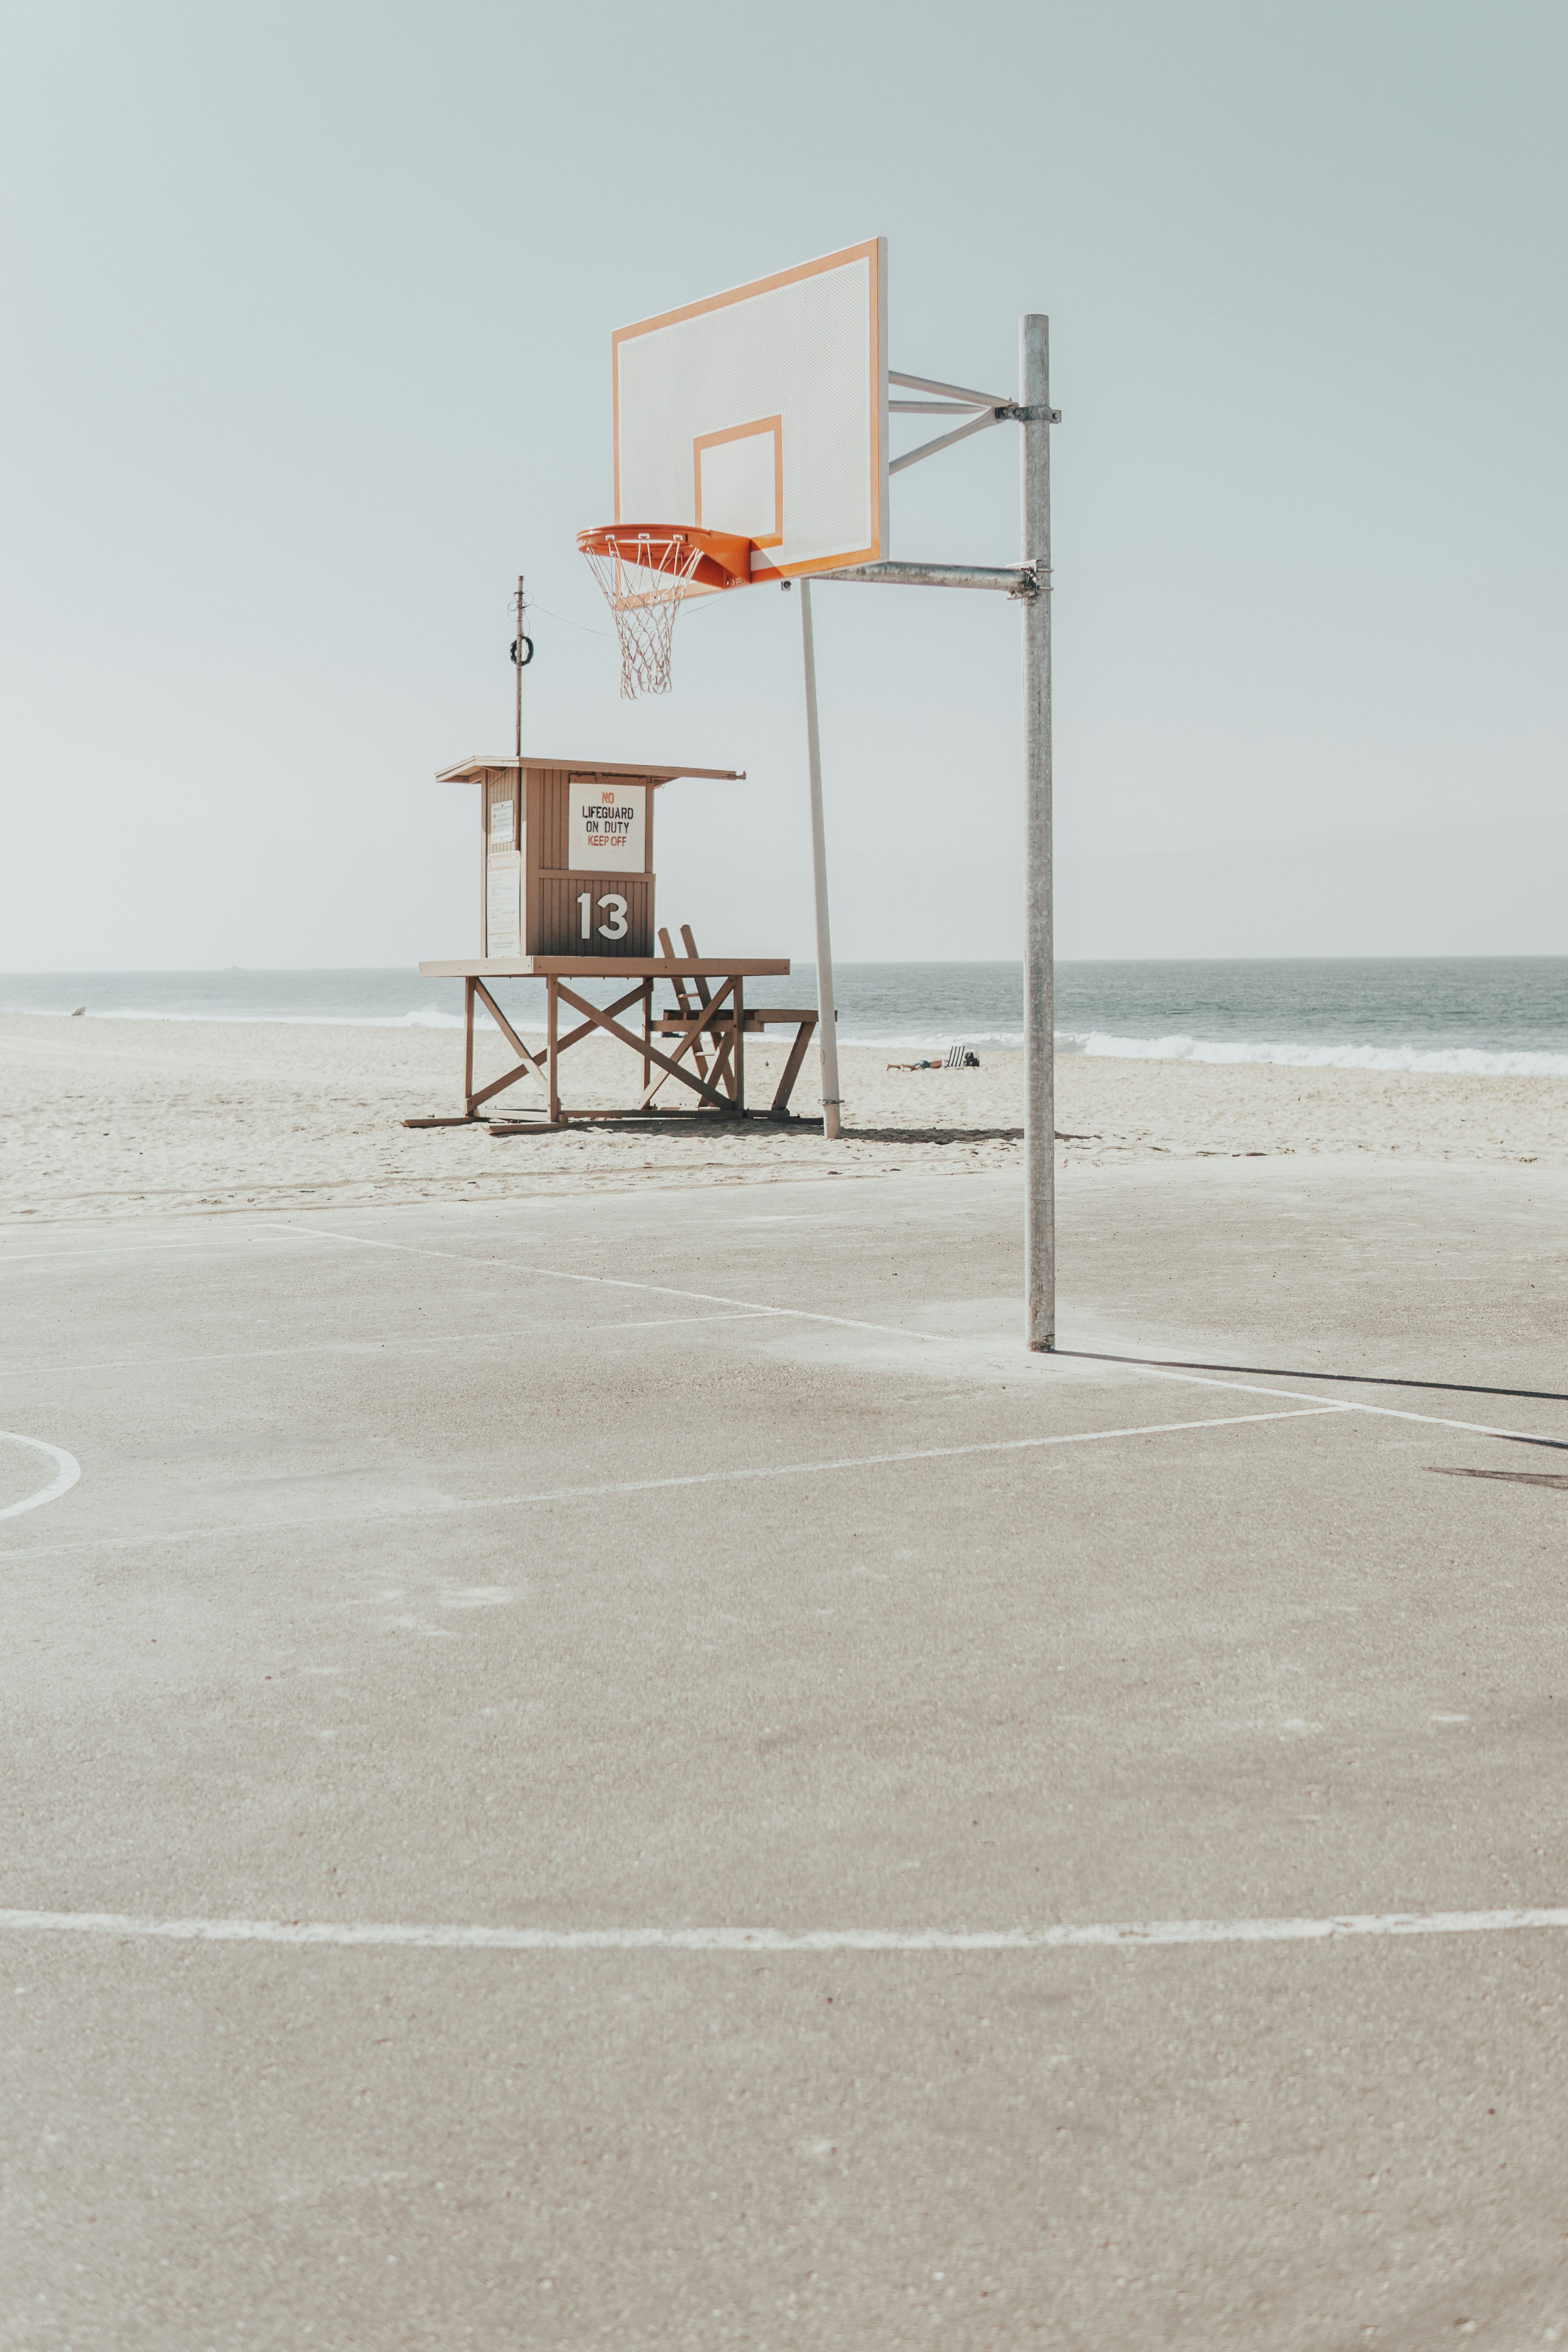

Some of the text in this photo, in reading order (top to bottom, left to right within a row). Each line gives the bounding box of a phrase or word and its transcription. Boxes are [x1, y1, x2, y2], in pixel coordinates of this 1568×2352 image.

[602, 792, 614, 804] NO
[582, 806, 633, 820] LIFEGUARD
[586, 821, 629, 834] ON DUTY
[588, 835, 626, 847] KEEP OFF
[491, 856, 516, 868] WARNING
[577, 892, 628, 940] 13
